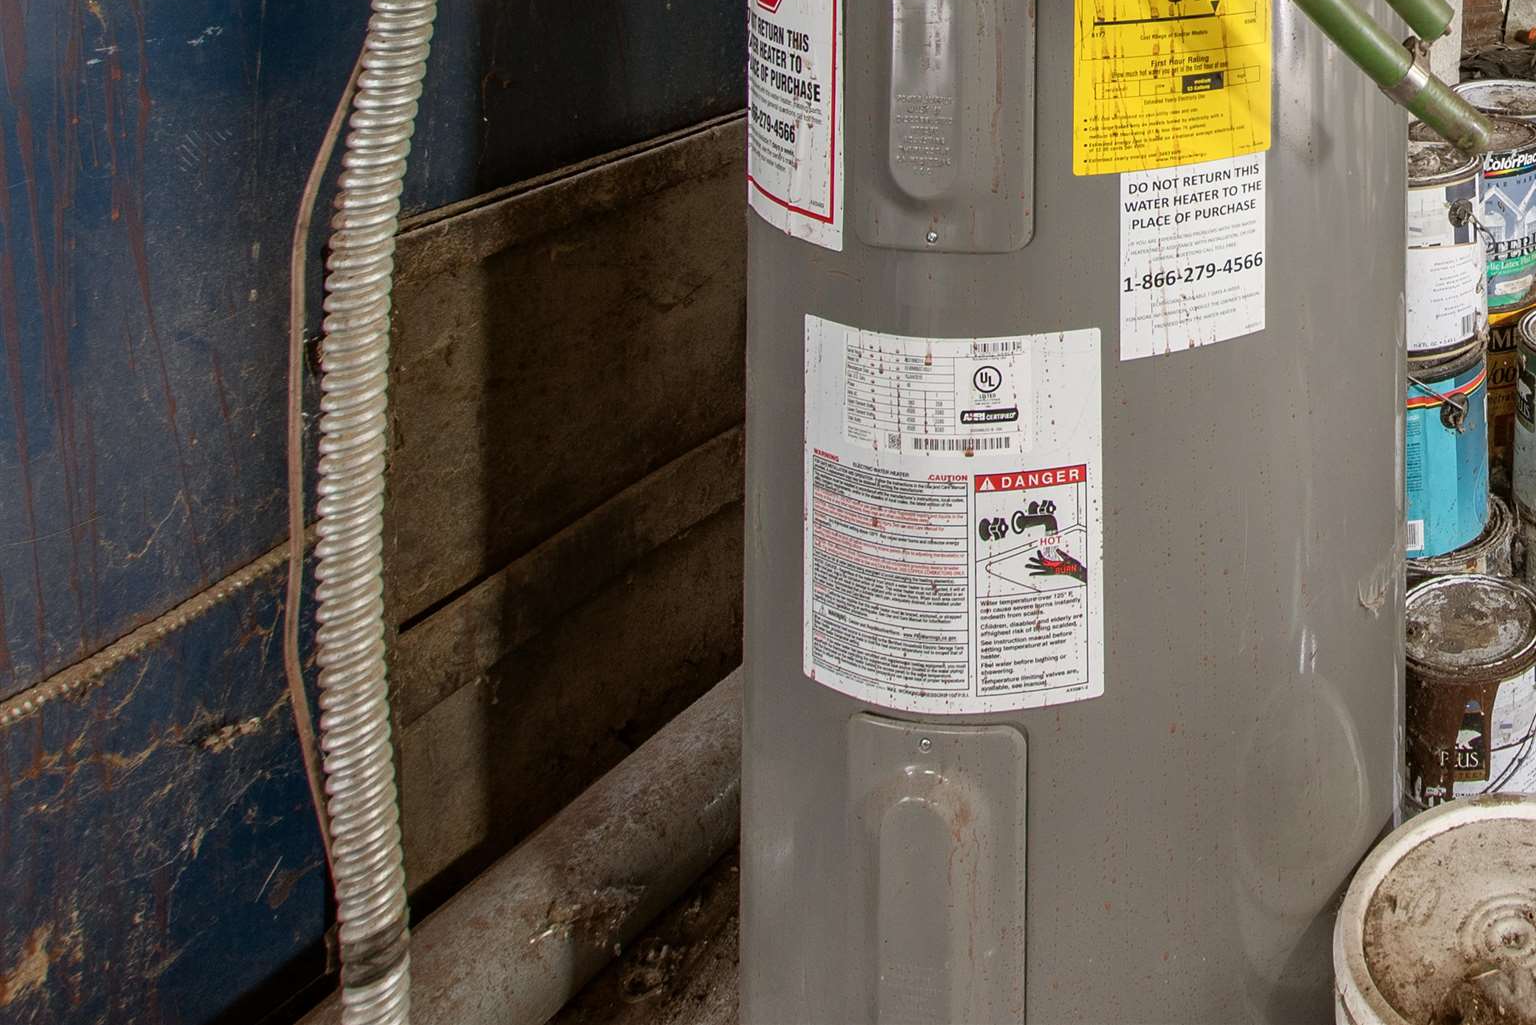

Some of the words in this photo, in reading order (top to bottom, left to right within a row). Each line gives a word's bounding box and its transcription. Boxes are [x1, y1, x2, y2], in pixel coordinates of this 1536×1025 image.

[758, 16, 785, 45] RETURN
[786, 29, 809, 53] THIS
[760, 40, 787, 69] HEATER
[789, 53, 802, 75] TO
[1151, 59, 1168, 68] First
[1169, 57, 1186, 66] Hour
[1188, 55, 1210, 64] Rating
[760, 63, 769, 83] OF
[770, 69, 821, 102] PURCHASE
[1128, 182, 1148, 195] DO
[1152, 177, 1179, 192] NOT
[1183, 169, 1231, 187] RETURN
[1234, 163, 1260, 177] THIS
[1124, 197, 1169, 213] WATER
[1173, 189, 1219, 207] HEATER
[1222, 185, 1238, 198] TO
[1242, 180, 1262, 194] THE
[1131, 214, 1171, 230] PLACE
[1174, 211, 1191, 224] OF
[1194, 198, 1257, 221] PURCHASE
[1123, 251, 1264, 293] 1-866-279-4566
[980, 371, 995, 387] UL
[928, 474, 968, 482] CAUTION
[1001, 468, 1080, 489] DANGER
[1040, 536, 1063, 546] HOT
[1055, 564, 1077, 574] BURN
[999, 597, 1037, 606] temperature
[1034, 601, 1053, 609] burns
[1054, 597, 1081, 606] instantly
[980, 623, 1009, 631] Children,
[1009, 620, 1037, 628] disabled
[1038, 617, 1050, 625] and
[1050, 614, 1072, 623] elderly
[1007, 611, 1022, 619] from
[1012, 627, 1024, 635] risk
[1033, 624, 1051, 634] being
[981, 645, 1002, 654] setting
[1003, 642, 1041, 652] temperature
[1049, 638, 1067, 646] water
[993, 636, 1028, 646] instruction
[1028, 633, 1052, 641] manual
[1052, 630, 1073, 639] before
[1013, 657, 1034, 665] before
[1034, 655, 1059, 664] bathing
[981, 675, 1020, 685] Temperature
[1020, 672, 1044, 681] limiting
[1045, 670, 1066, 678] valves
[1440, 751, 1479, 768] PUS
